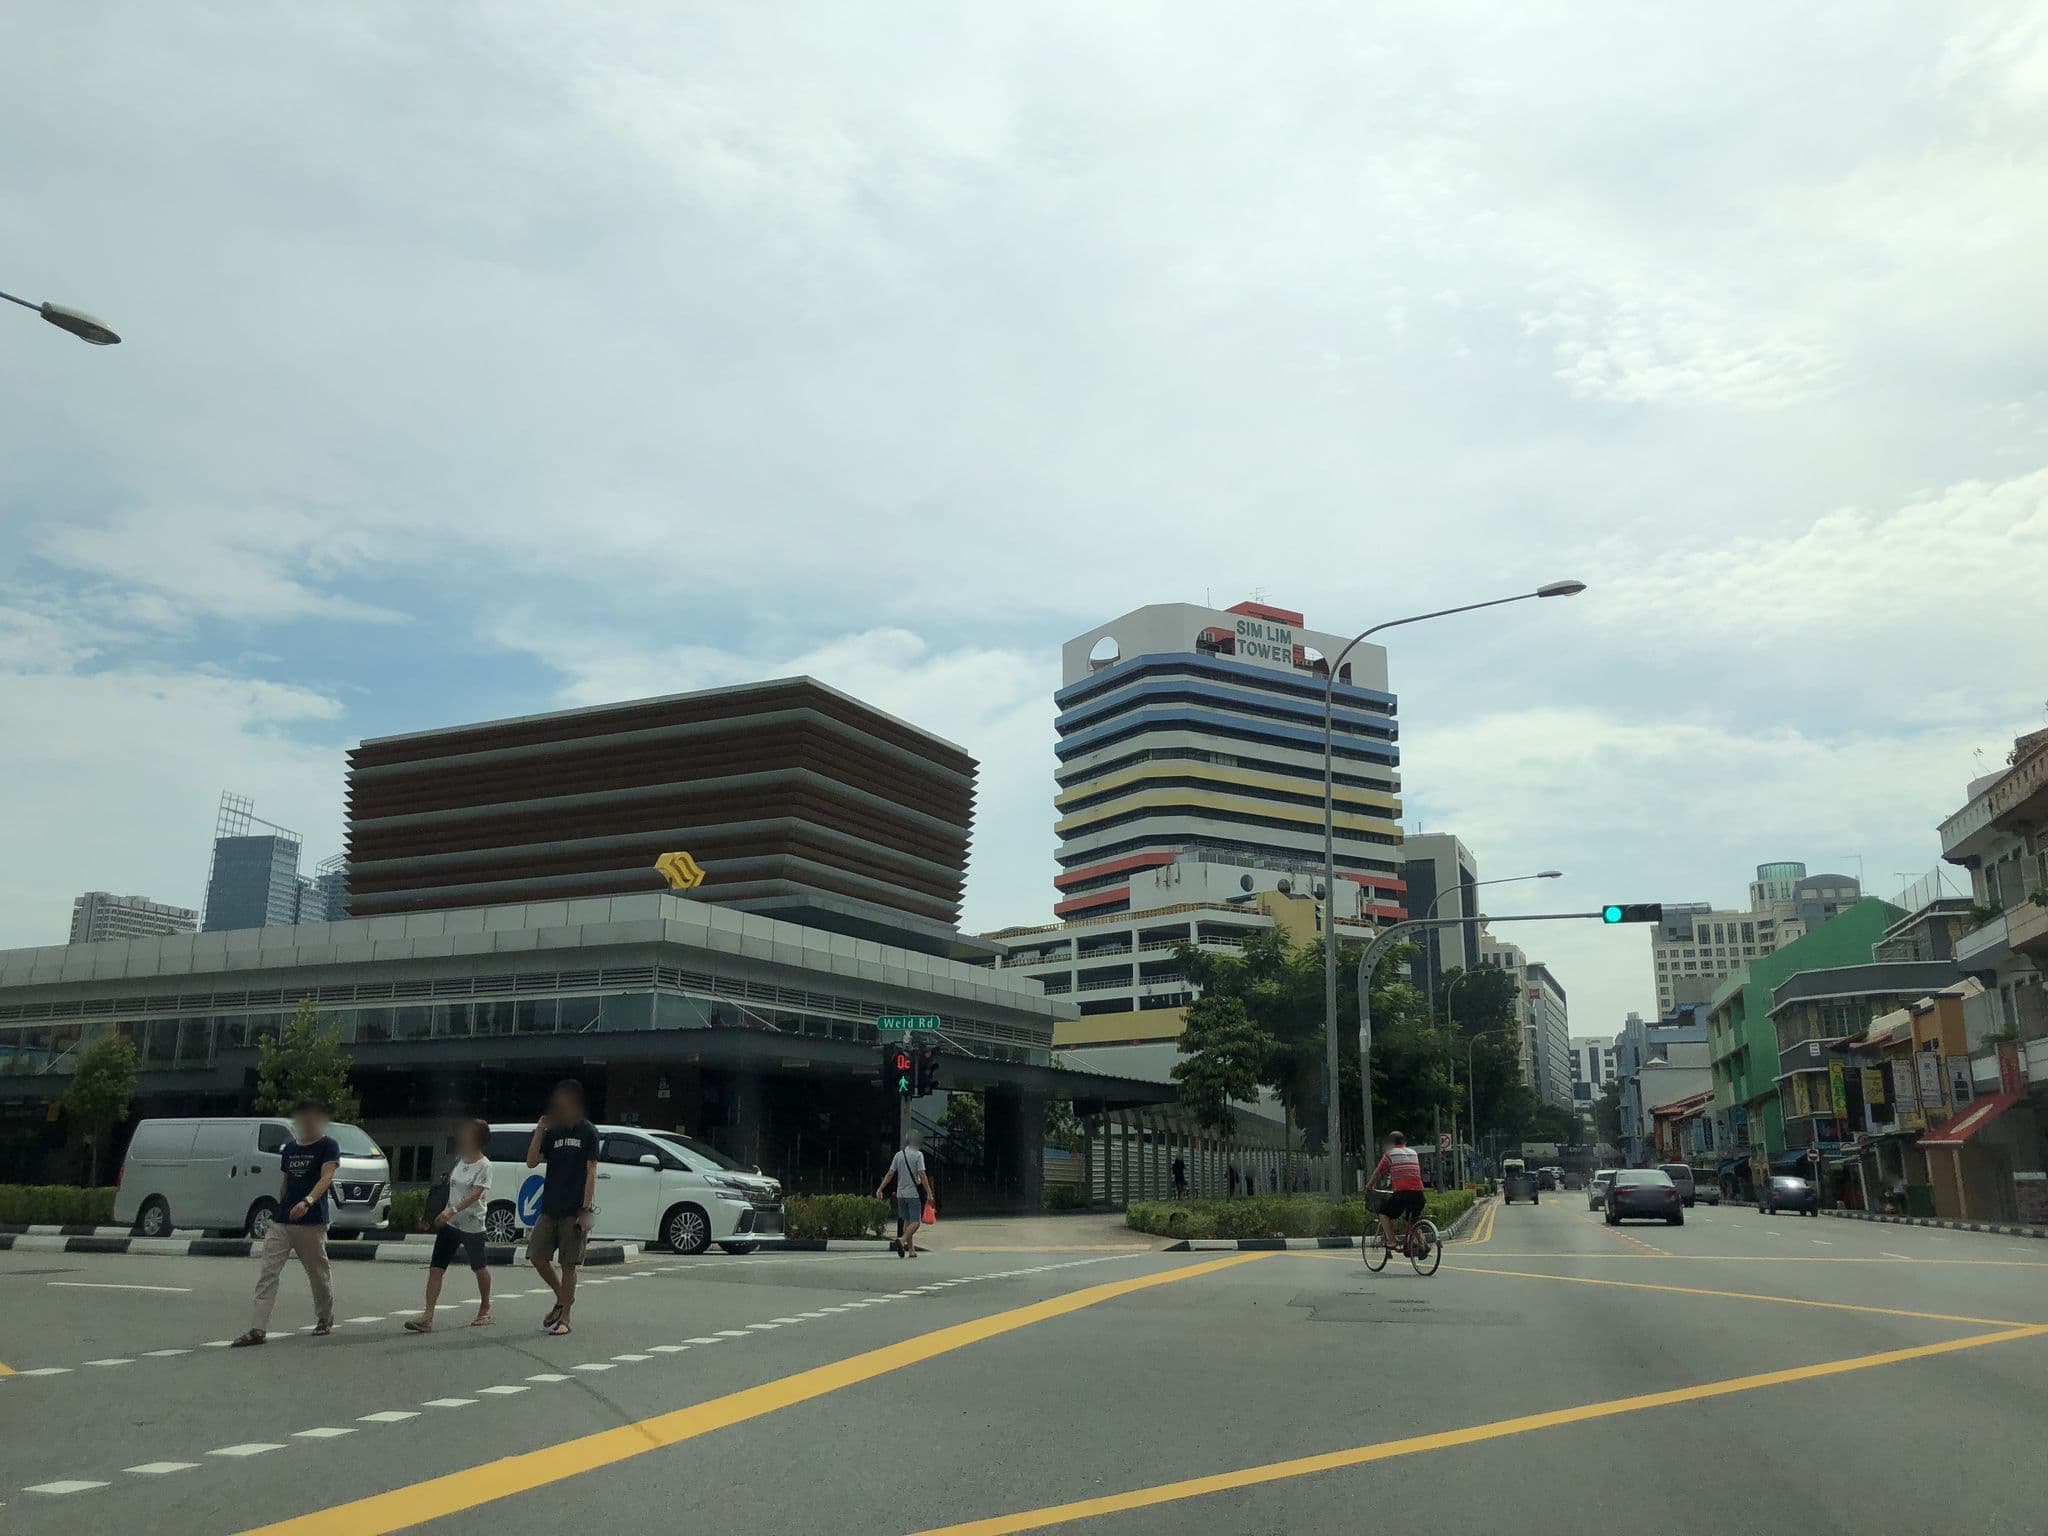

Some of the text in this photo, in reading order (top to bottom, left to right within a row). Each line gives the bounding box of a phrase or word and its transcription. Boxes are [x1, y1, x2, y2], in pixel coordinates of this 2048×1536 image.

[1236, 620, 1292, 645] SIM LIM
[1236, 638, 1292, 665] TOWER
[883, 1017, 933, 1029] Weld Rd
